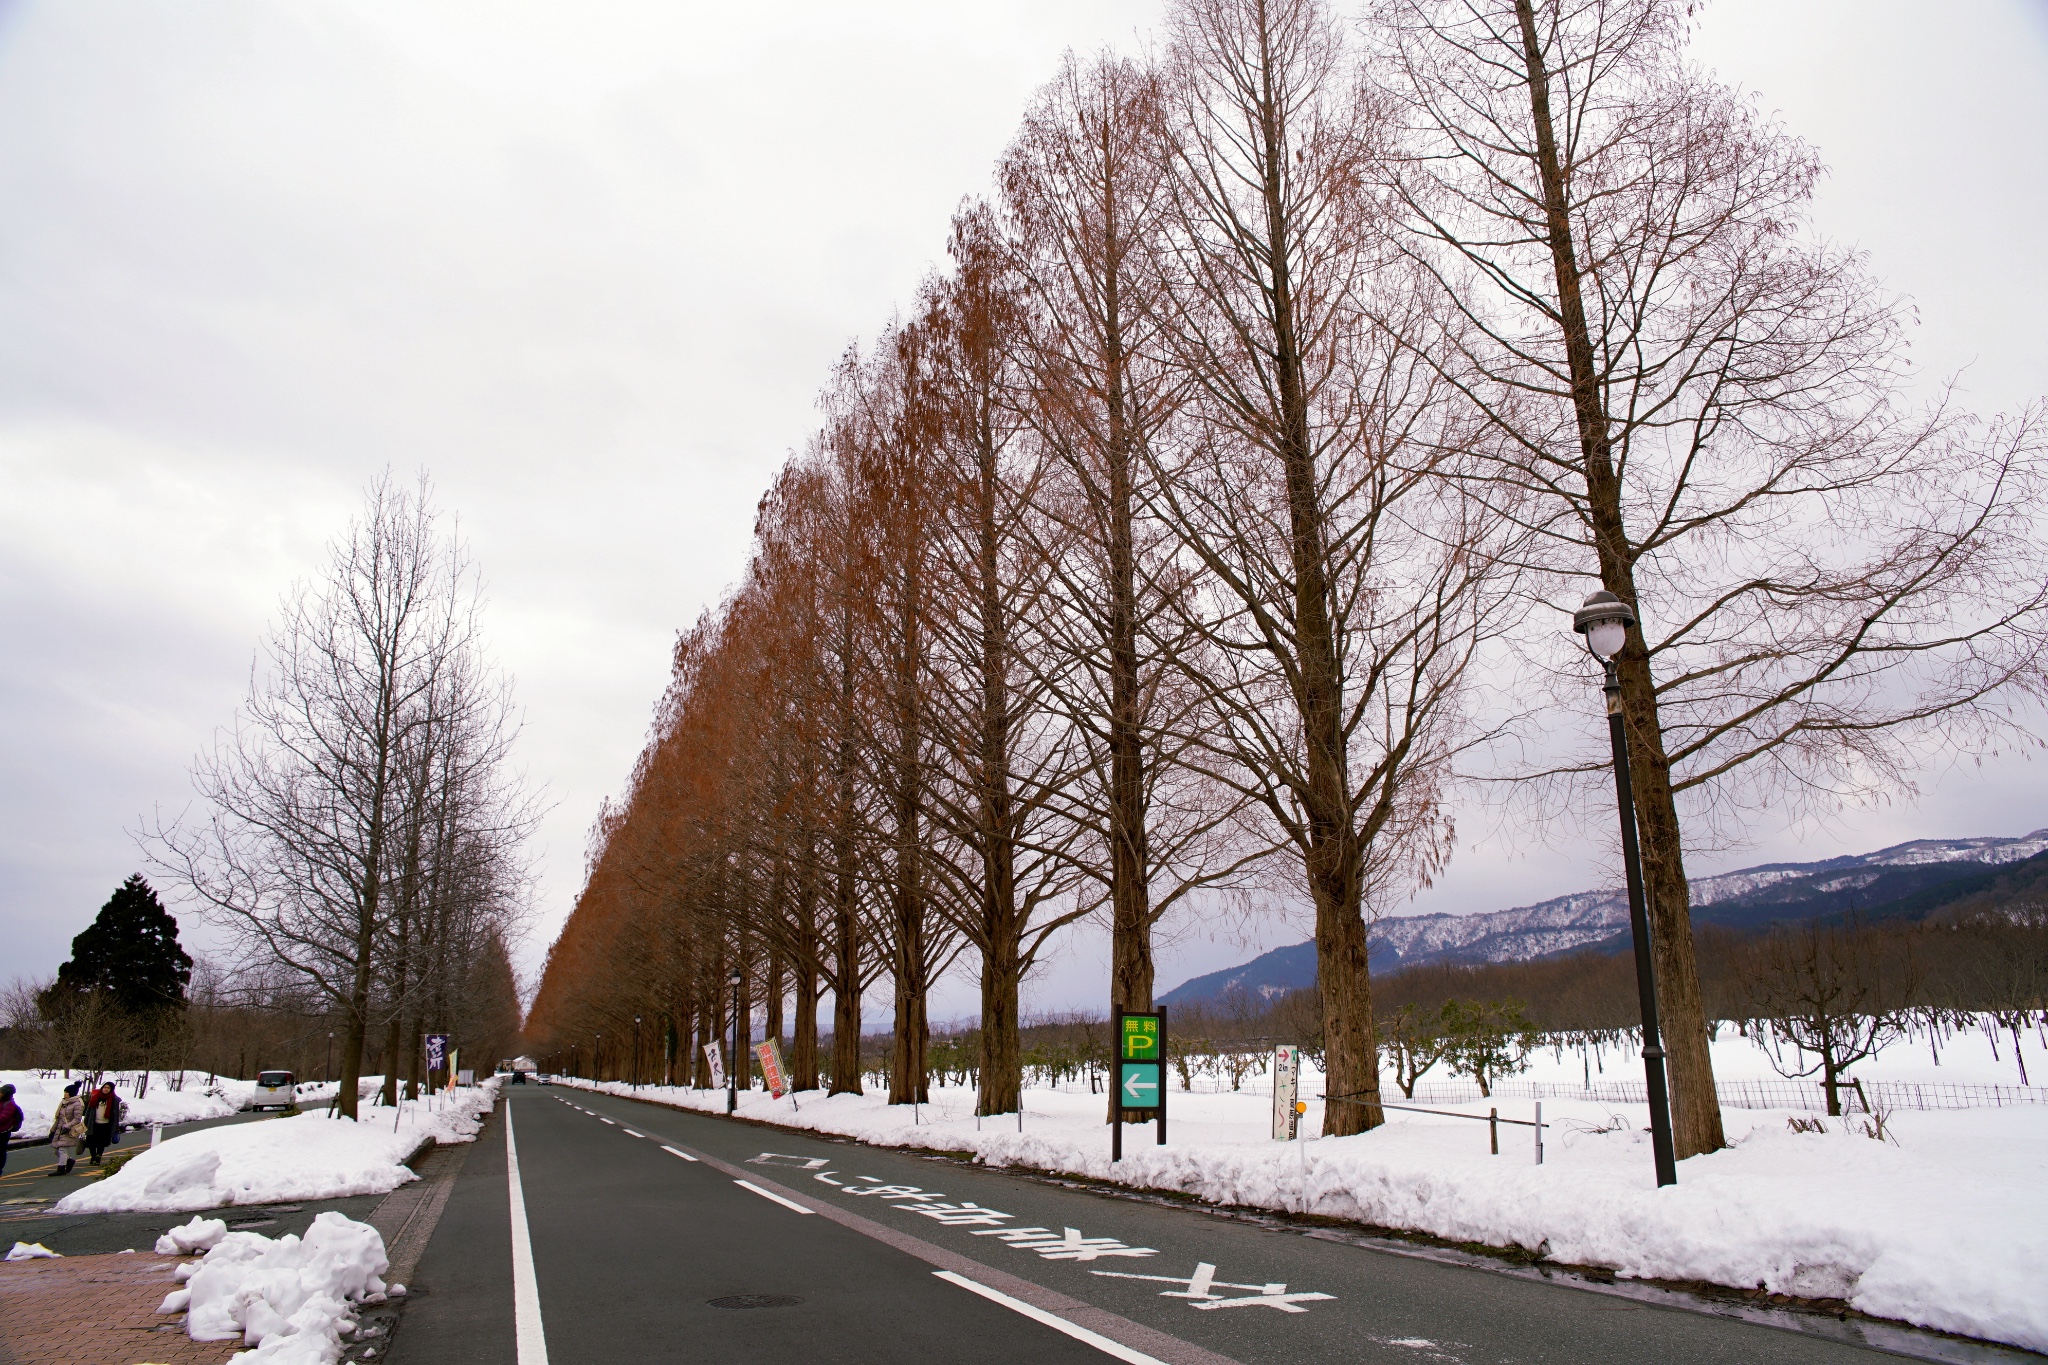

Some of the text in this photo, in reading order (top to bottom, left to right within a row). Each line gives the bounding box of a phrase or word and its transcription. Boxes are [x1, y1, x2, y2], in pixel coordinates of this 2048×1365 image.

[1125, 1019, 1156, 1033] 無料
[1128, 1035, 1153, 1057] P
[813, 1171, 1338, 1313] 交差点あり
